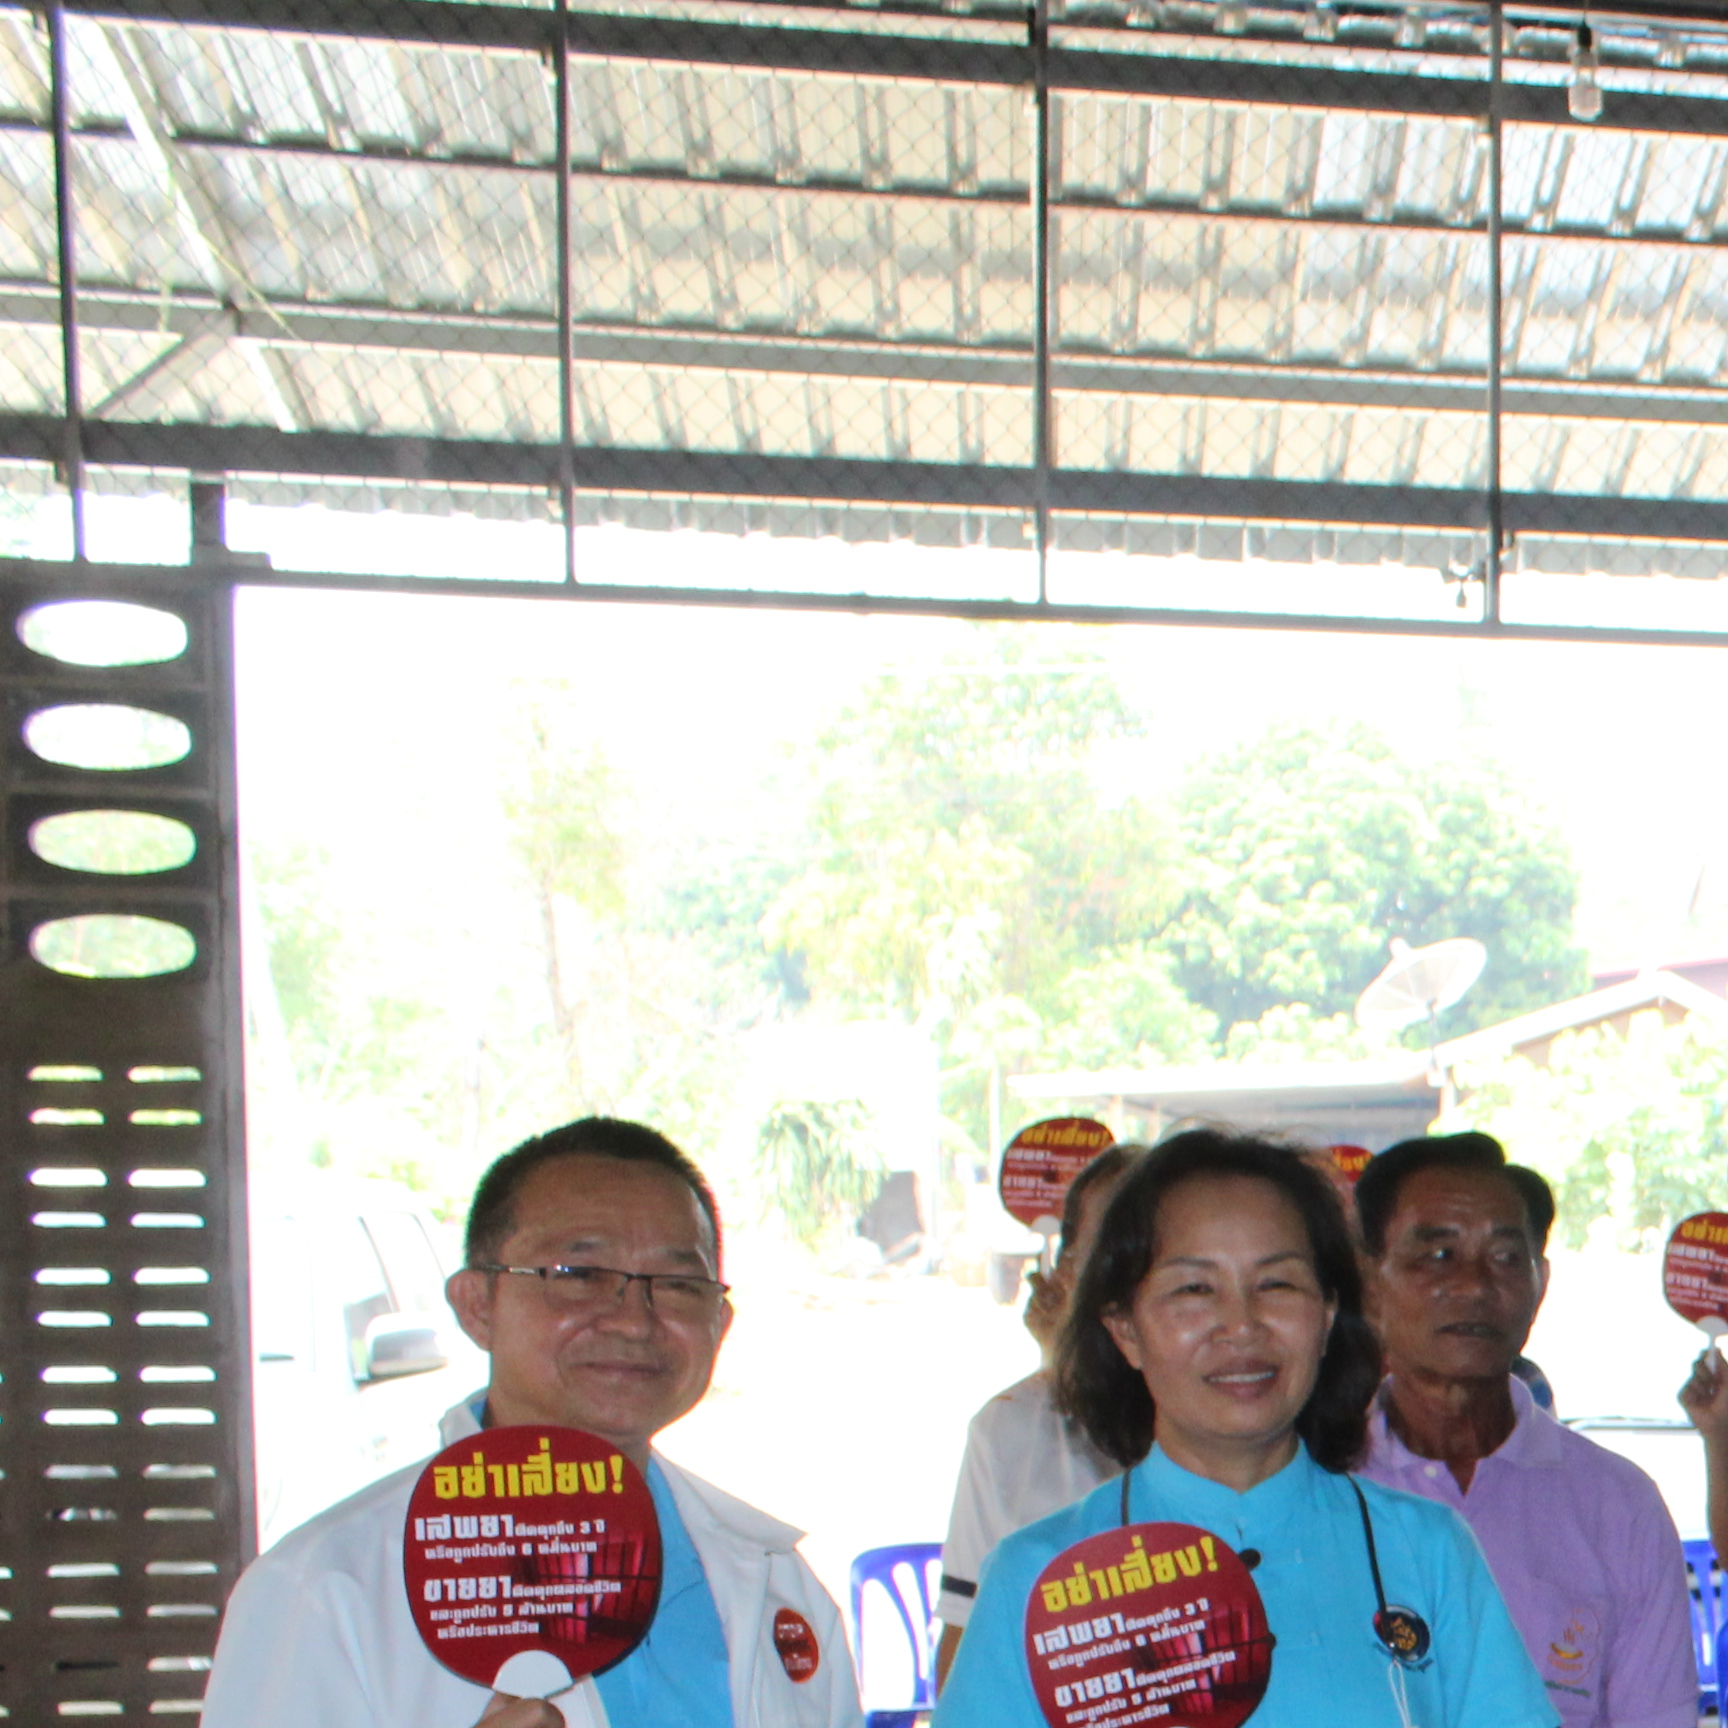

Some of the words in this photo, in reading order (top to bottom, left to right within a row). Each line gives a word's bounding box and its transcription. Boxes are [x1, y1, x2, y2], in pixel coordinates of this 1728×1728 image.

[433, 1437, 624, 1499] อย่าเสี่ยง!
[414, 1514, 514, 1541] เสพยา
[424, 1575, 513, 1602] ขายยา
[1041, 1535, 1219, 1613] อย่าเสี่ยง!
